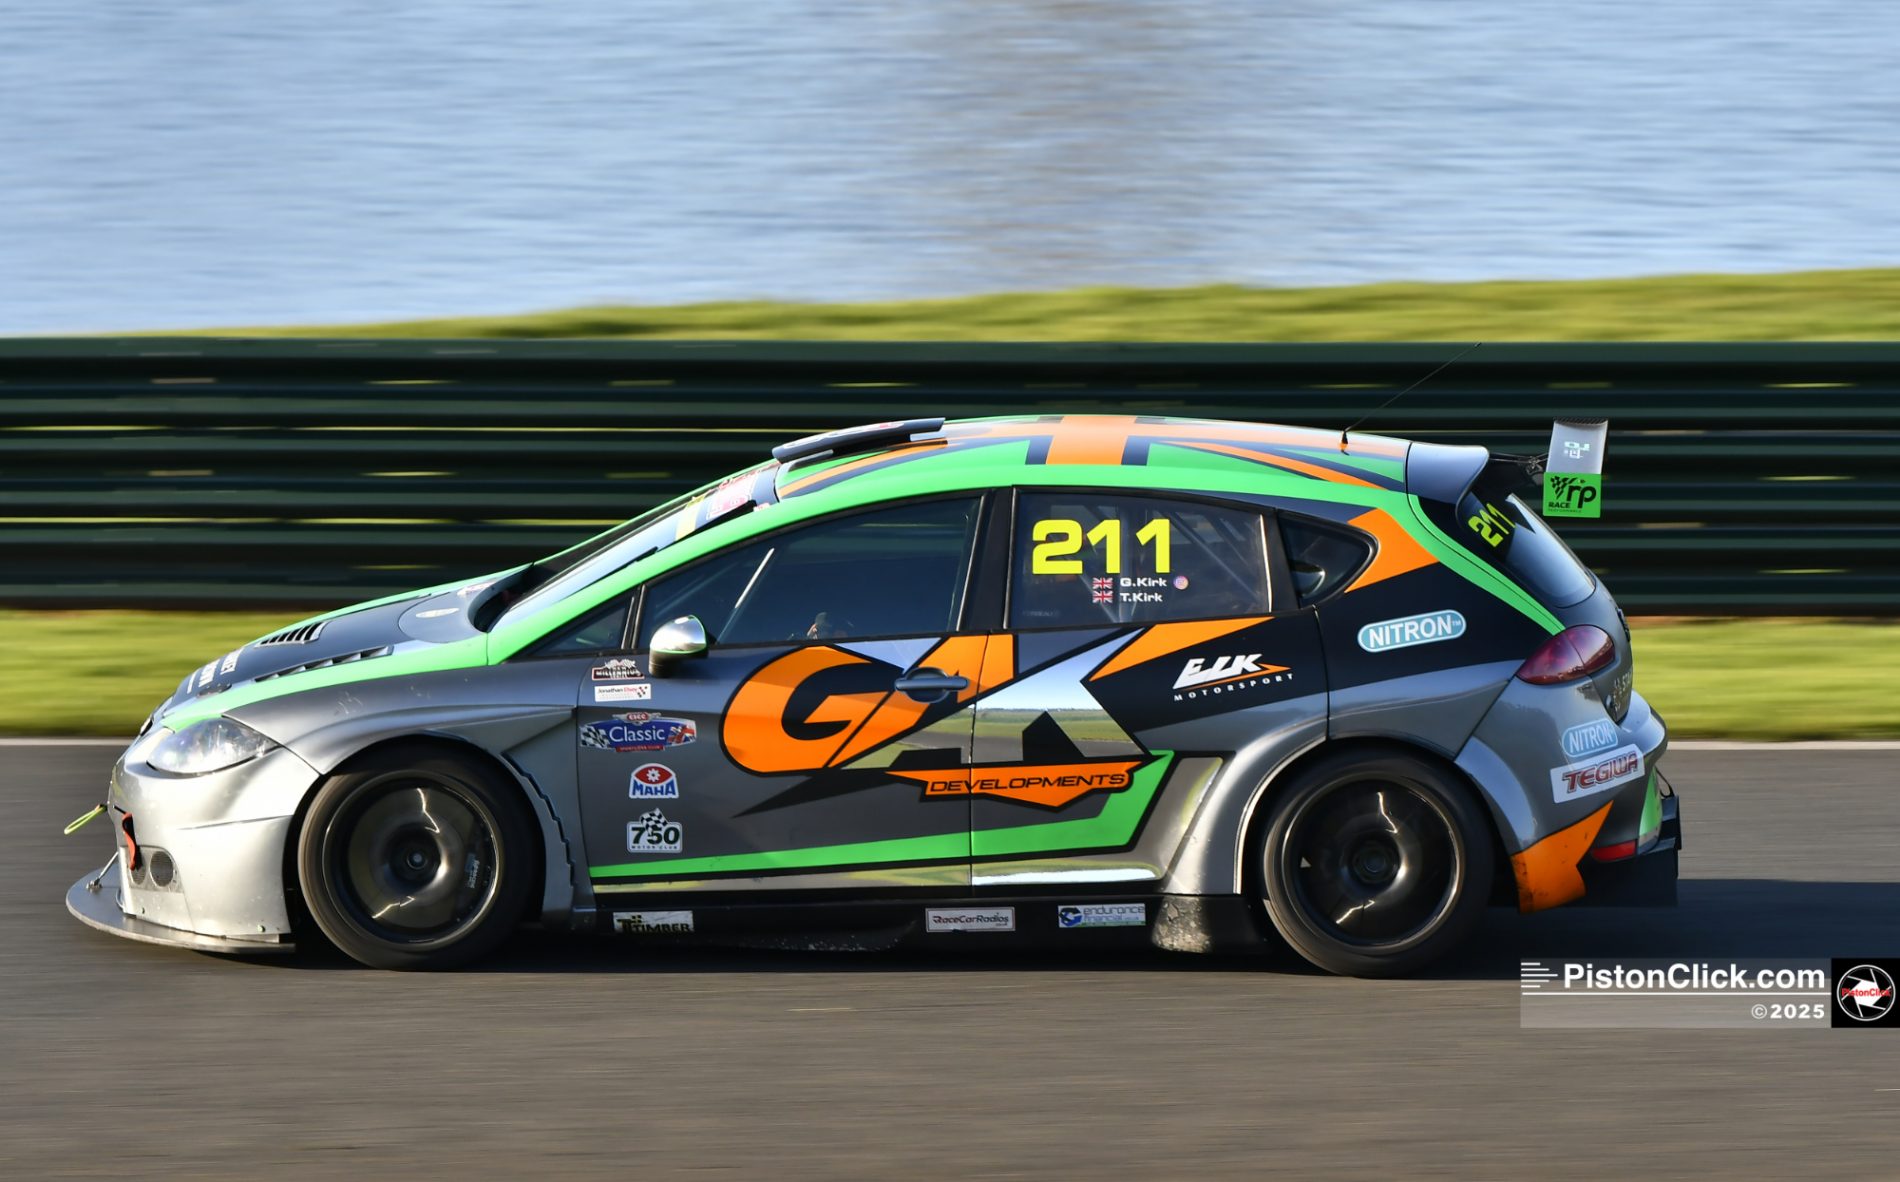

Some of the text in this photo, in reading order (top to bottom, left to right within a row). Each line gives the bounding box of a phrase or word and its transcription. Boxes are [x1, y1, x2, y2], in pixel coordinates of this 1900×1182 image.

[1468, 502, 1517, 547] 211
[1032, 519, 1171, 575] 211
[1119, 577, 1168, 588] G.Kirk
[1119, 592, 1163, 602] T.Kirk
[1368, 614, 1452, 648] NITRON
[1174, 673, 1294, 702] MOTORSPORT
[609, 725, 666, 743] Classic
[1568, 723, 1613, 754] NITRON
[1562, 751, 1639, 794] TEGIWA
[632, 778, 677, 796] MAHA
[929, 773, 1126, 792] DEVELOPMENTS
[631, 826, 681, 845] 750
[1083, 905, 1145, 915] endurance
